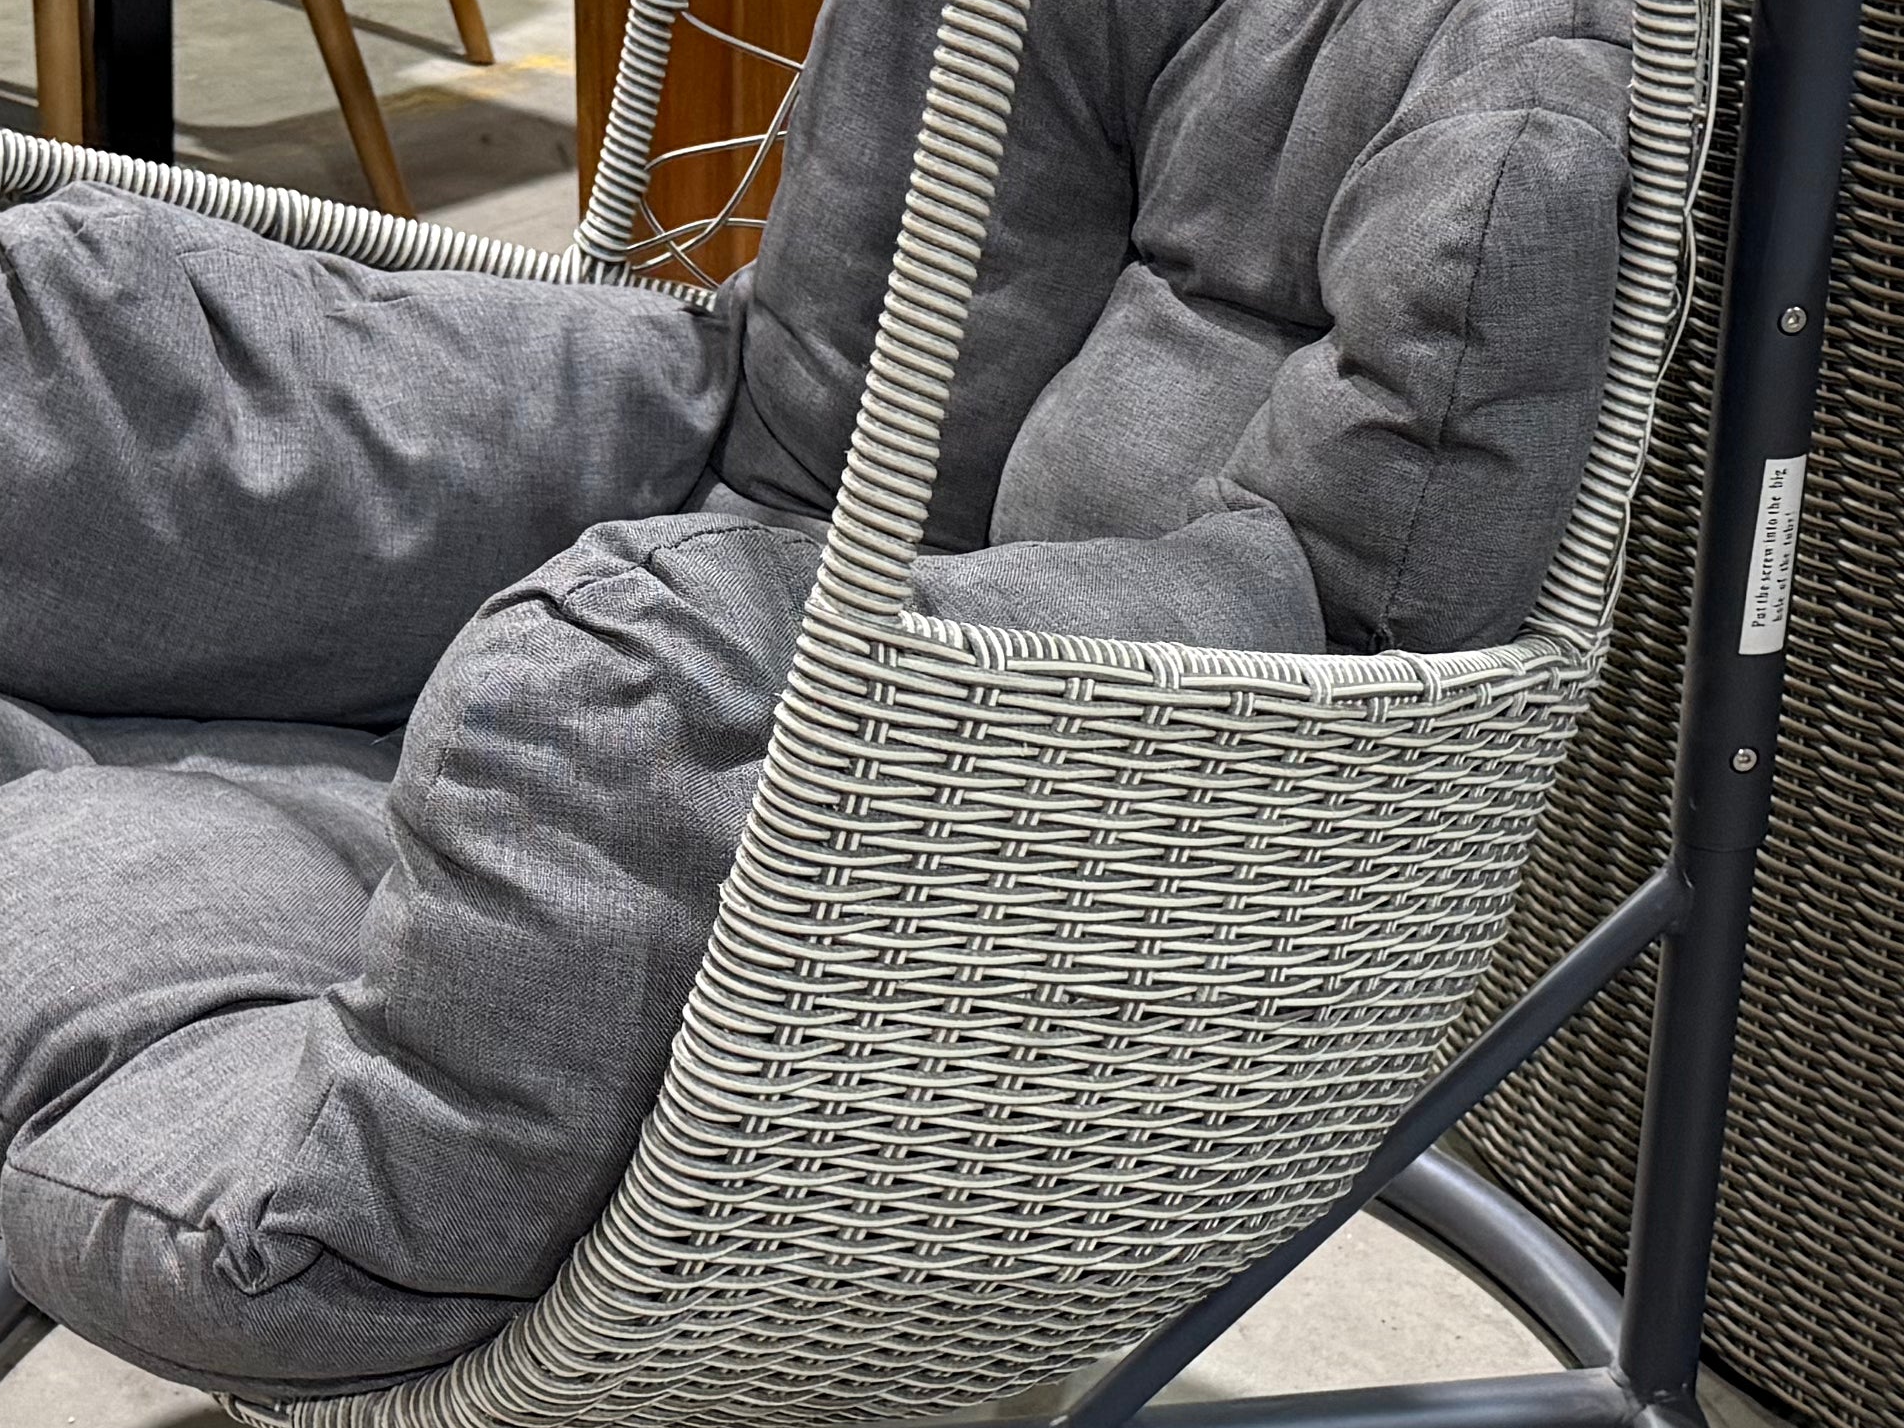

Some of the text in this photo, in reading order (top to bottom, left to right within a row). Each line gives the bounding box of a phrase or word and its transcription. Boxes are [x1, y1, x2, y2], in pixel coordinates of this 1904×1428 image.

[1751, 468, 1788, 627] Put the screw into the big
